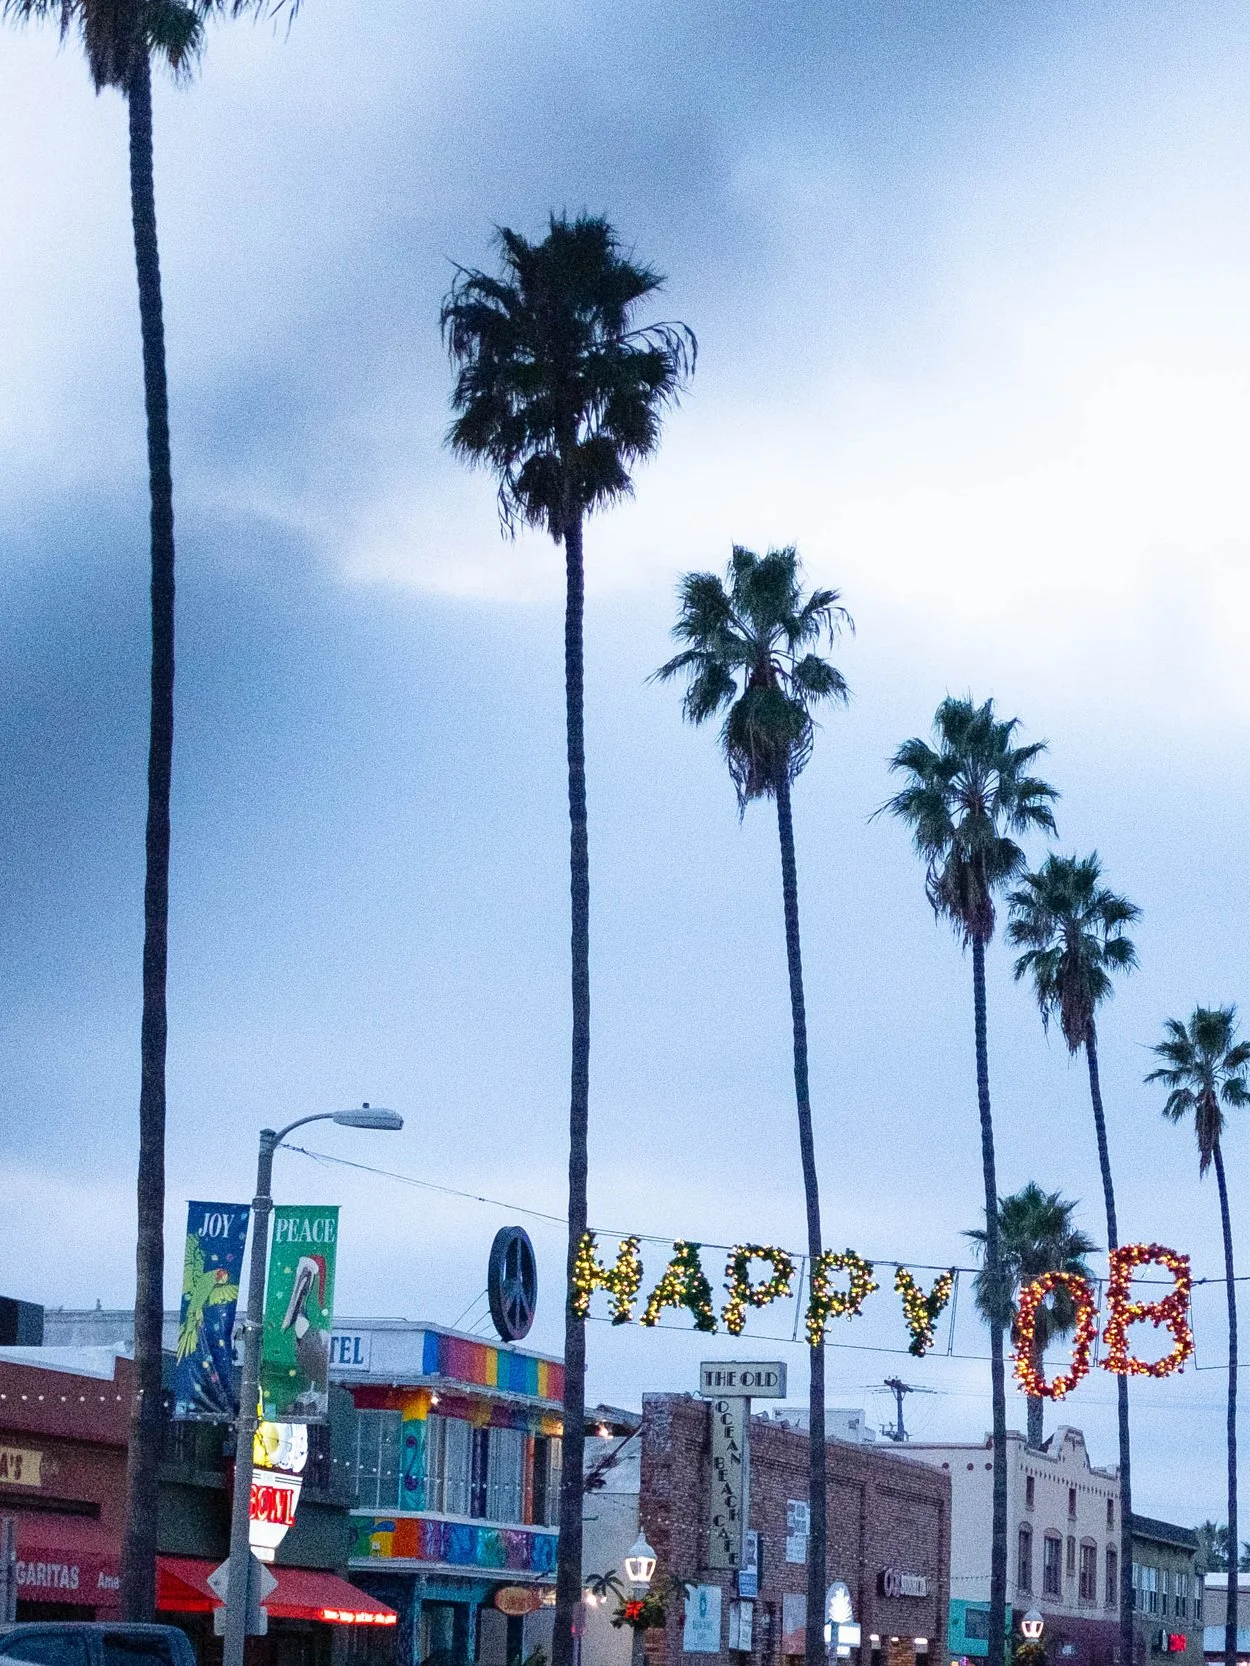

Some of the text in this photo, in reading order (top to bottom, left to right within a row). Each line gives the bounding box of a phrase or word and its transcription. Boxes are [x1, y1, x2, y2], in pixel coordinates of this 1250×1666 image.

[198, 1213, 236, 1238] JOY
[275, 1218, 336, 1243] PEACE
[573, 1229, 956, 1357] HAPPY
[1009, 1242, 1196, 1401] OB
[704, 1371, 779, 1387] THE OLD
[713, 1400, 742, 1566] OCEAN BEACH CAFE
